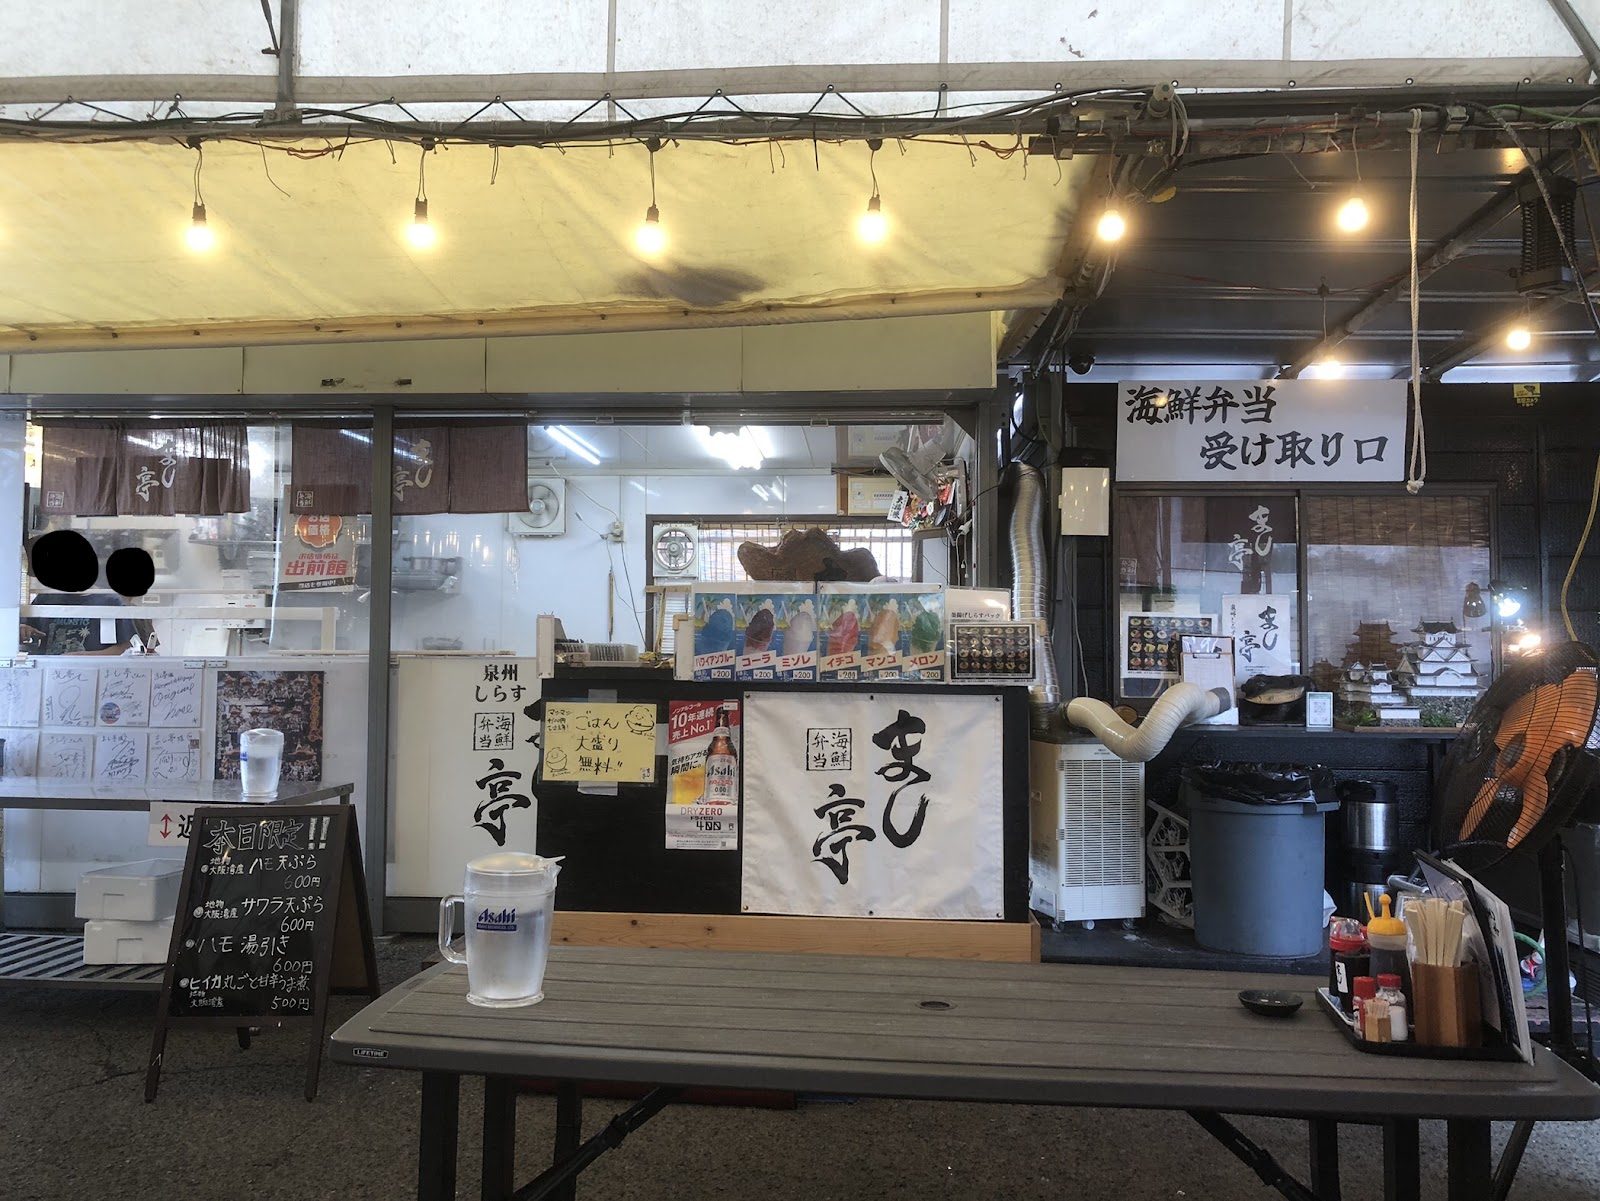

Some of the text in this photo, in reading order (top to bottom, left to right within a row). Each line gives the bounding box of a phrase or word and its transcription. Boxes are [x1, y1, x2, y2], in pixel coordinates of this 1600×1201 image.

[1125, 385, 1277, 425] 海鮮弁当
[1200, 430, 1389, 470] 受け取り口
[285, 560, 348, 576] 出前館
[742, 653, 771, 668] コーラ
[910, 654, 938, 668] メロン
[483, 664, 518, 681] 泉州
[475, 684, 526, 702] しらす
[576, 710, 620, 731] ごはん
[671, 706, 715, 729] 10年連続
[575, 734, 619, 752] 大盛り
[707, 765, 736, 778] Asahi
[472, 758, 532, 847] 亭
[284, 875, 321, 889] 600円
[241, 895, 325, 915] サワラ天ぷら
[478, 908, 516, 923] Asahi
[280, 916, 315, 932] 600円
[273, 958, 314, 974] 600円
[271, 995, 310, 1010] 500円
